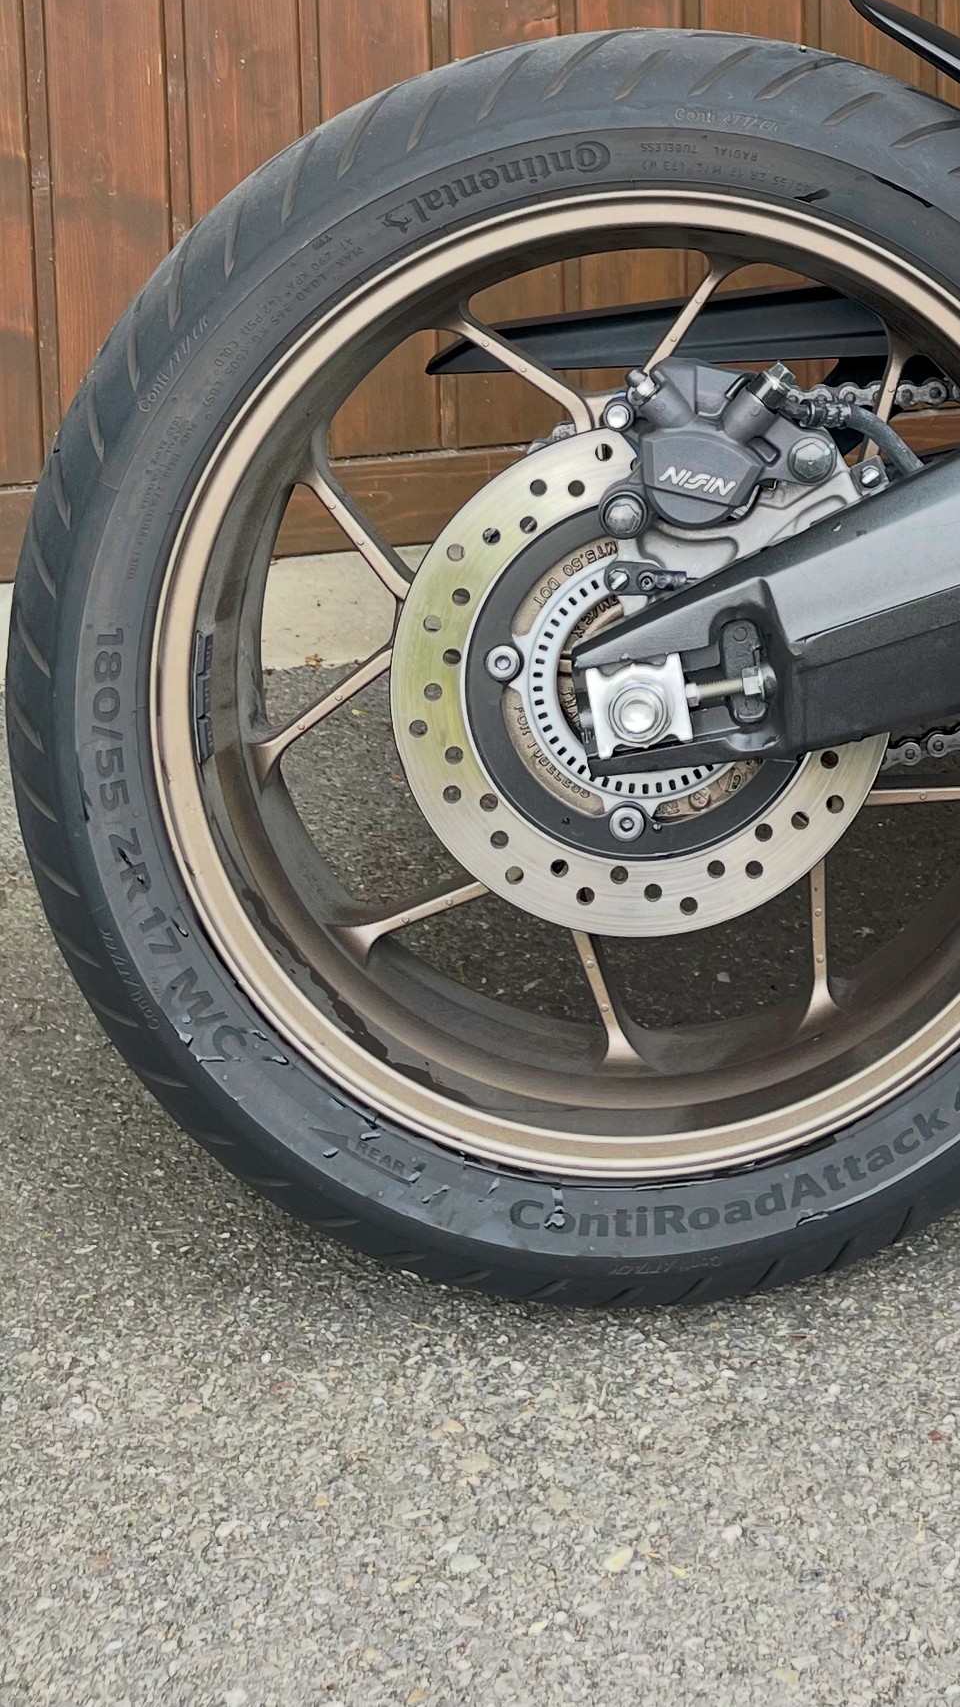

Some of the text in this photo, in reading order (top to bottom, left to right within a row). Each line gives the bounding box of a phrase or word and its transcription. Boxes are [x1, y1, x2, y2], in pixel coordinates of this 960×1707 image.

[414, 140, 612, 223] Continental
[640, 140, 759, 163] RADIAL TUBELESS
[534, 541, 618, 608] MT5.50 DOT
[91, 627, 248, 1062] 180/55 ZR 17 M/C
[355, 1139, 406, 1174] REAR
[508, 1105, 950, 1236] ContiRoadAttack
